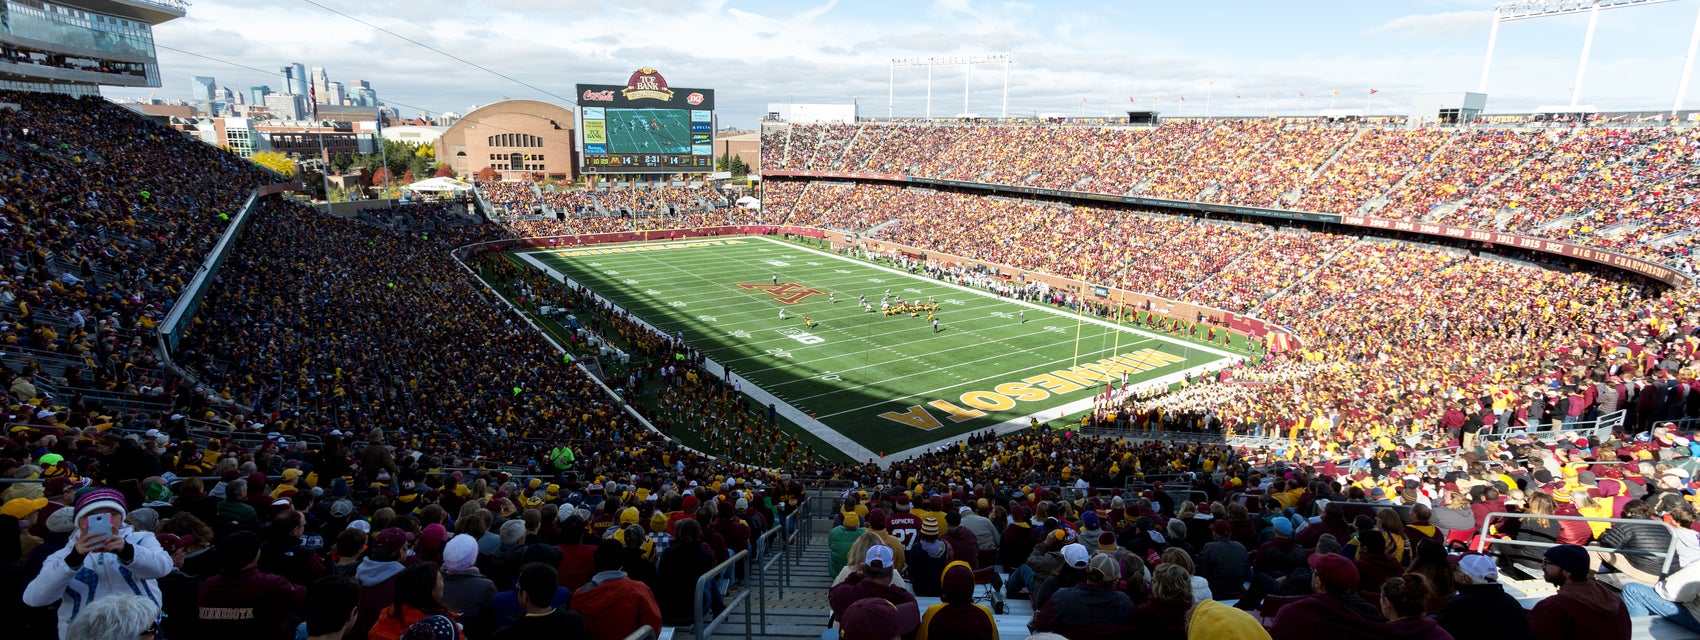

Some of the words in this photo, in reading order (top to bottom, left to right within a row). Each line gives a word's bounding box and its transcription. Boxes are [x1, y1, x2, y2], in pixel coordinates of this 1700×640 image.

[637, 82, 659, 90] BANK
[622, 156, 631, 165] 14
[670, 156, 679, 165] 14
[1395, 221, 1414, 231] 1904
[1471, 231, 1490, 241] 1910
[1496, 234, 1515, 244] 1911
[1520, 238, 1541, 249] 1915
[1572, 247, 1590, 258] BIG
[1595, 251, 1610, 263] TEN
[877, 347, 1187, 431] MINNESOTA
[198, 607, 254, 620] MINNESOTA
